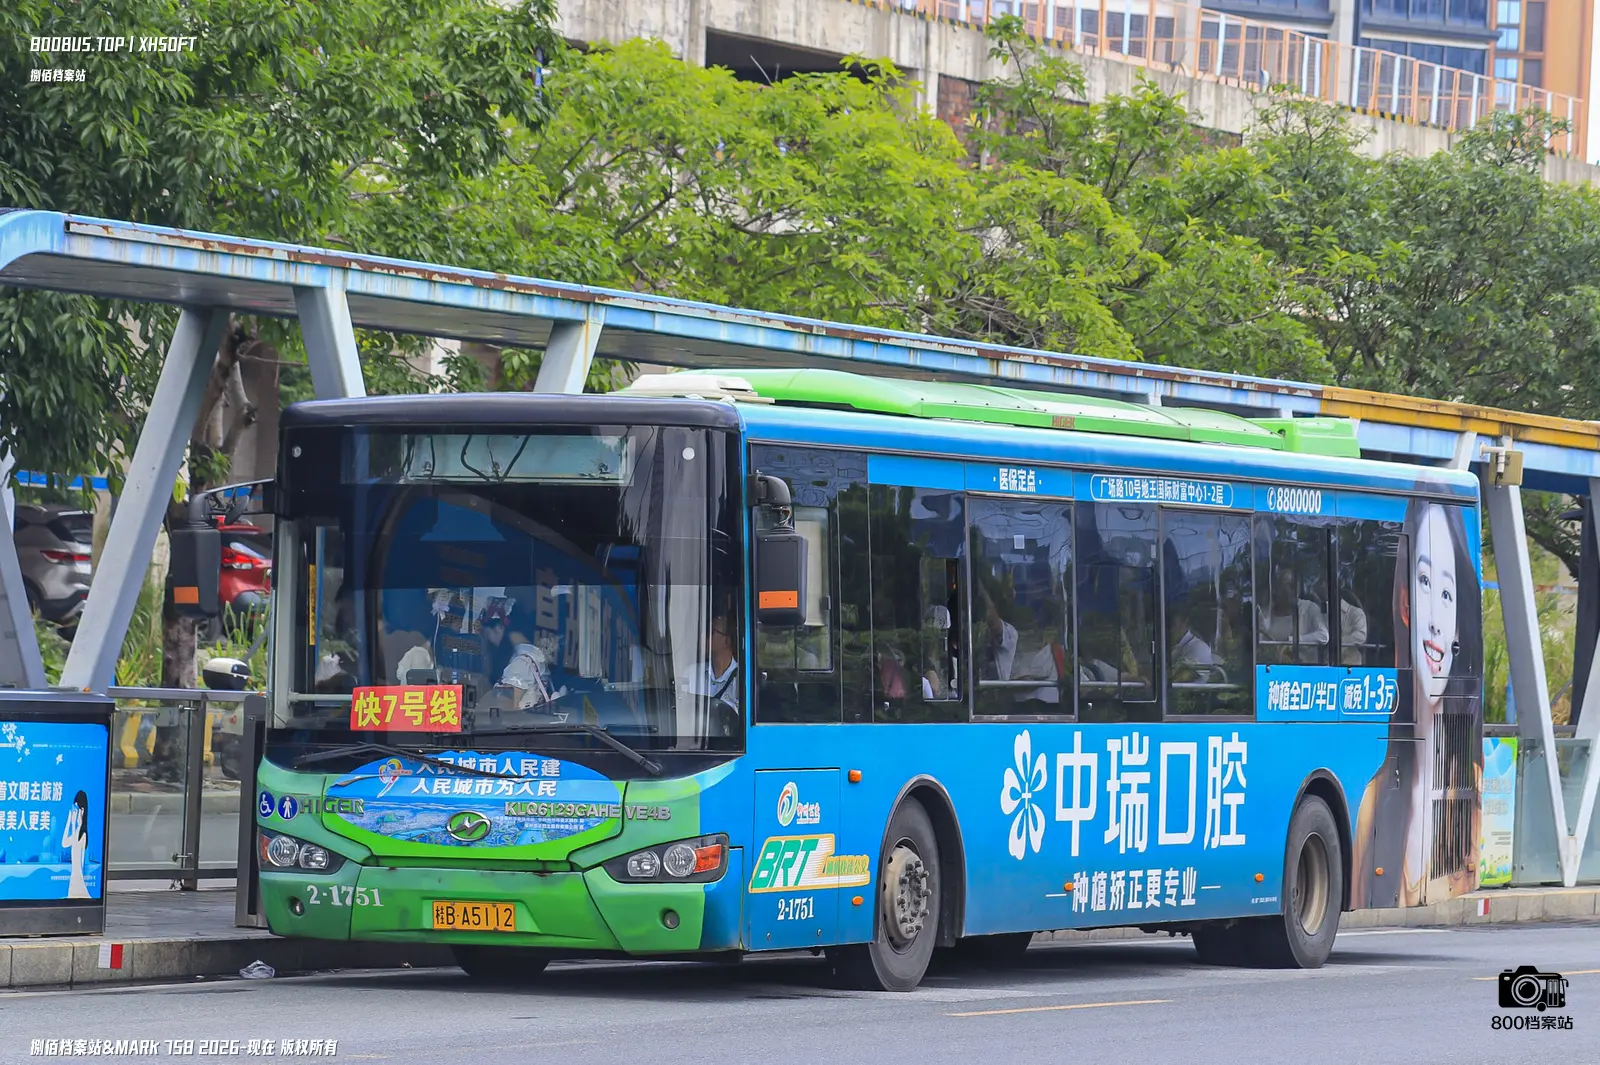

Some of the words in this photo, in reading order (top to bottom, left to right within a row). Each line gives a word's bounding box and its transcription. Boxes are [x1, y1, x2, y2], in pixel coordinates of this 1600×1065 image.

[1099, 477, 1224, 504] 广场路10号地王国际财富中心1-2层
[1277, 487, 1321, 513] 8800000
[1267, 680, 1337, 711] 种植全口/半口
[1343, 674, 1394, 711] 减免1-3万
[354, 690, 459, 727] 快7号线
[416, 757, 561, 777] 人民城市人民建
[410, 777, 557, 797] 人民城市为人民
[1055, 731, 1248, 857] 中瑞口腔
[299, 798, 365, 817] HIGER
[750, 838, 820, 889] BRT
[306, 885, 384, 907] 2-1751
[1072, 867, 1198, 914] 种植矫正更专业
[777, 896, 815, 920] 2-1751
